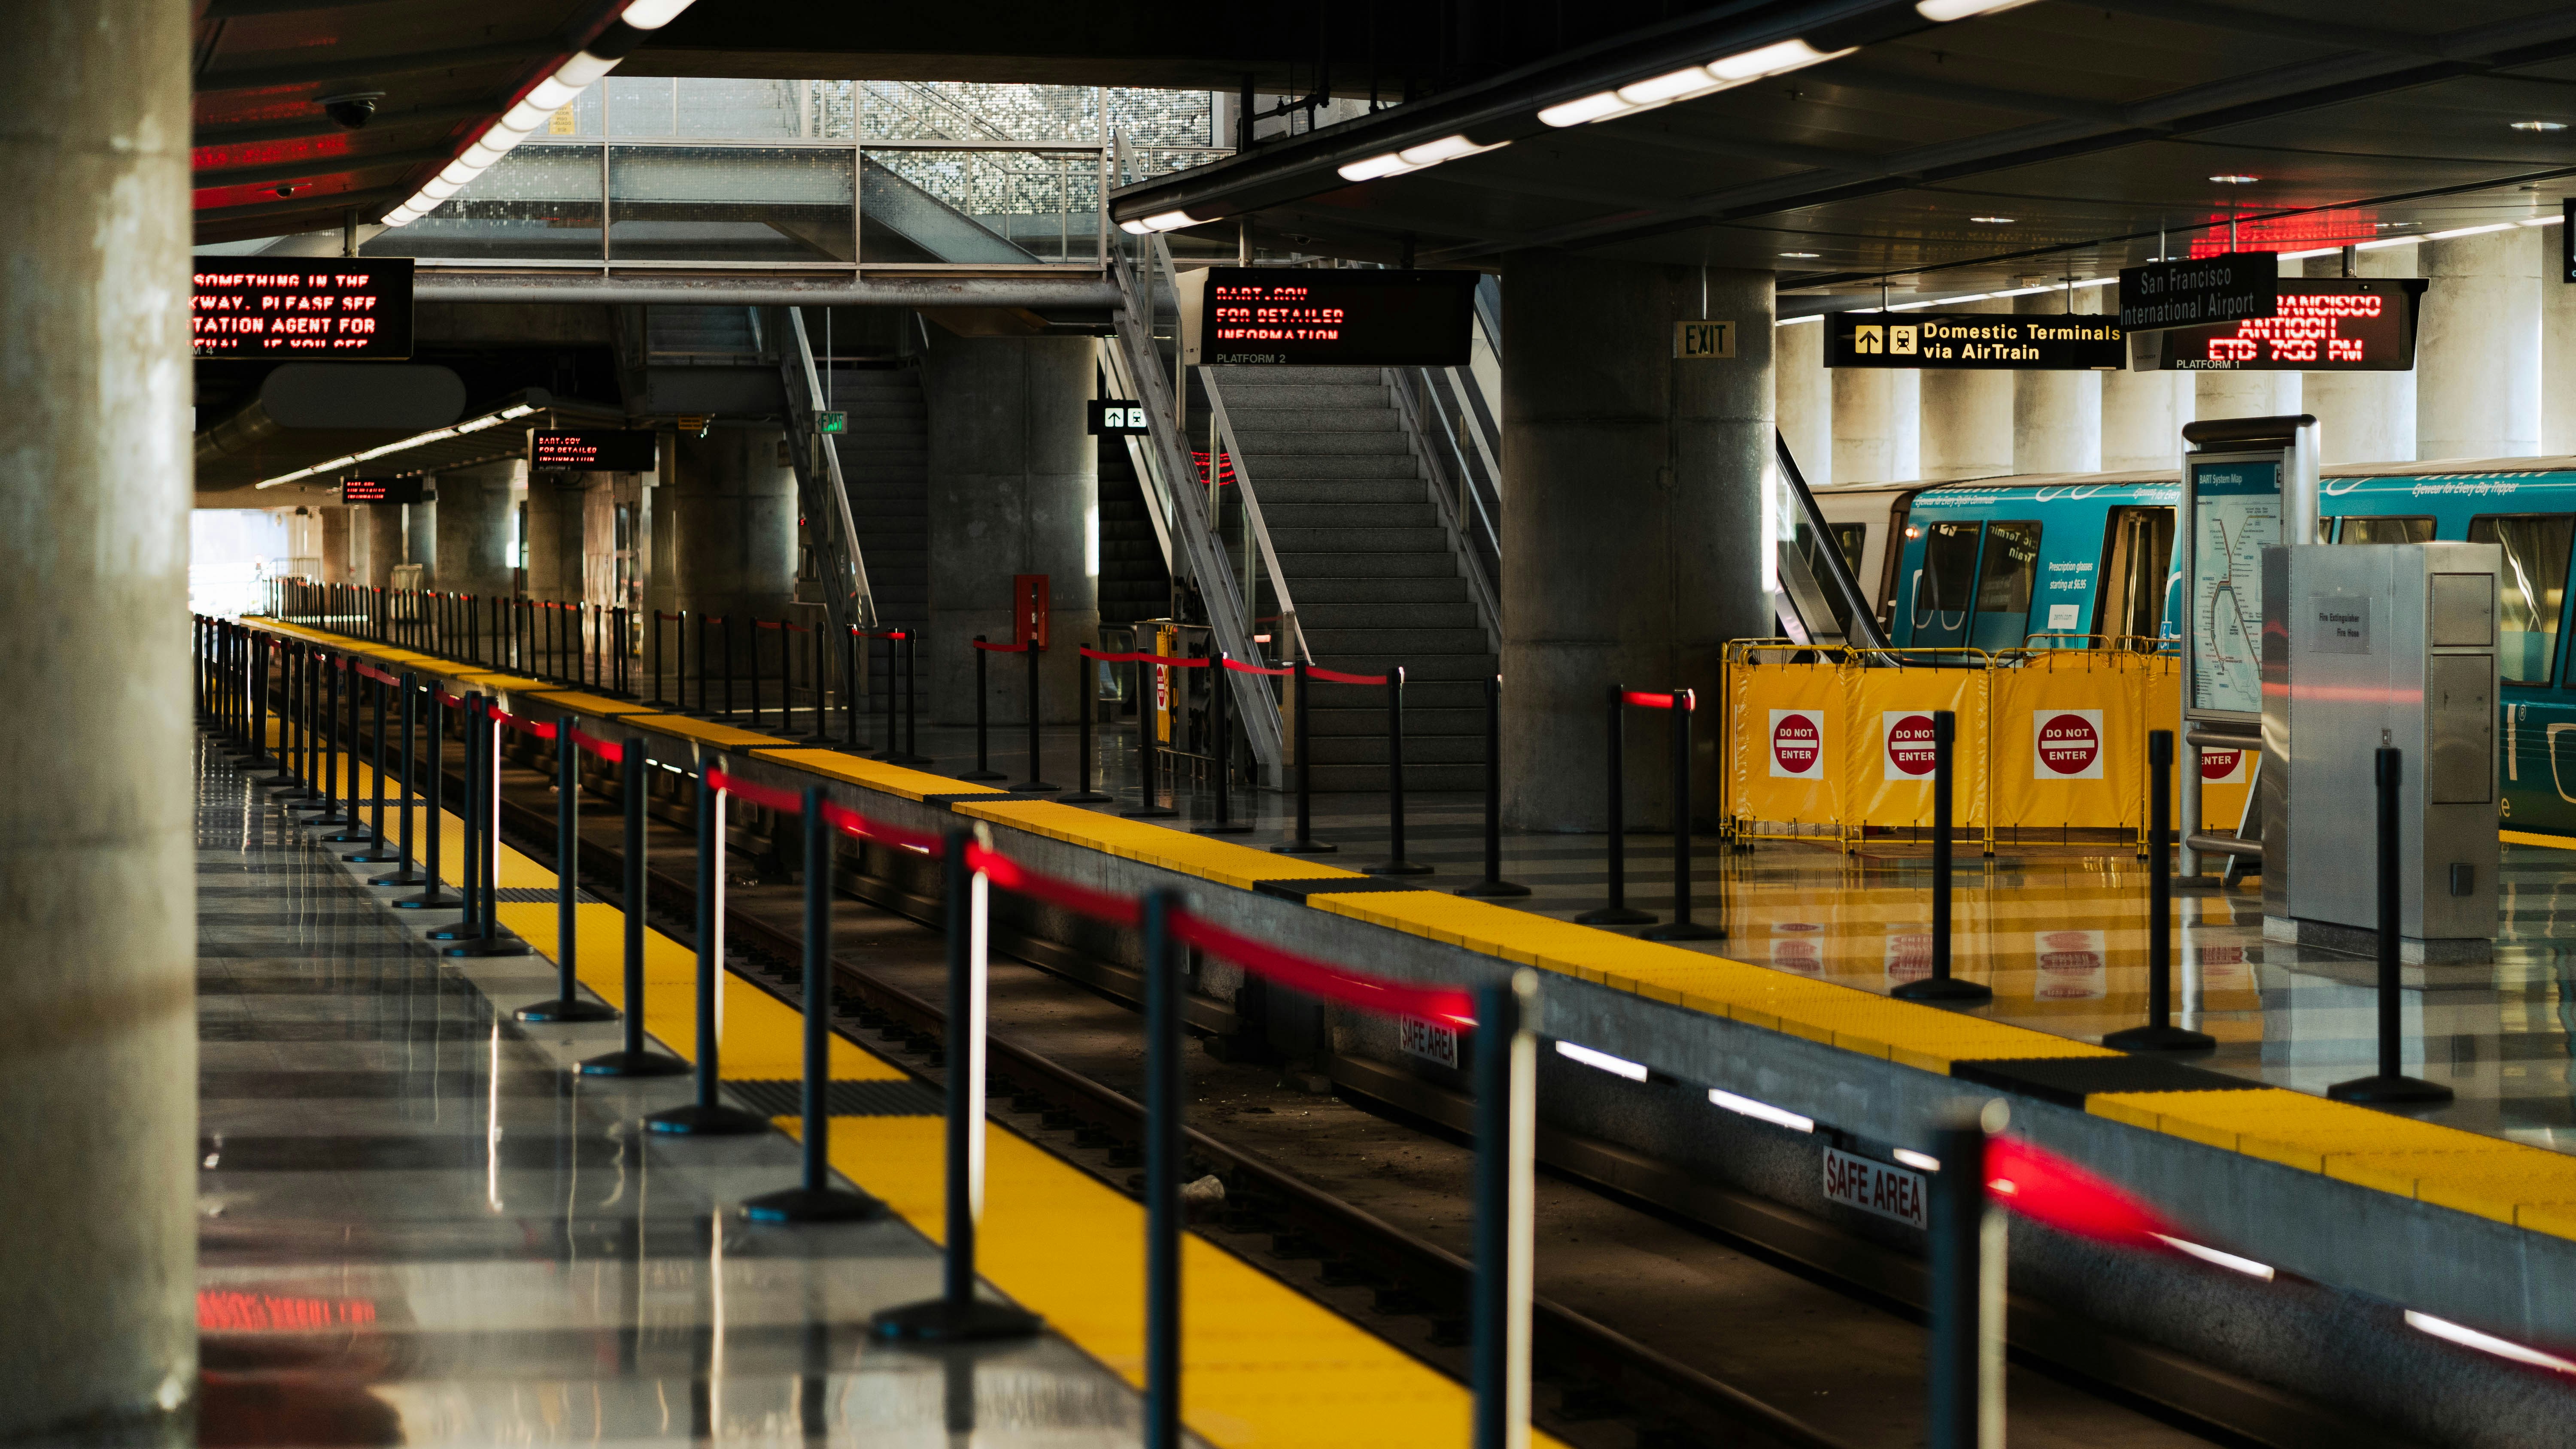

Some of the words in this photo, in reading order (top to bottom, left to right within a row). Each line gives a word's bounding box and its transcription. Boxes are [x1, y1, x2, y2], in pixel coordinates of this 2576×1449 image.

[308, 275, 327, 288] IN
[2141, 272, 2164, 294] San
[2169, 265, 2232, 291] Francisco
[2120, 295, 2201, 326] International
[2208, 291, 2254, 318] Airport
[2277, 295, 2382, 318] RANCISCO
[1216, 308, 1250, 323] FOR
[193, 317, 264, 333] TATION
[271, 317, 332, 333] AGENT
[339, 317, 376, 333] FOR
[1924, 322, 2018, 340] Domestic
[2027, 324, 2121, 341] Terminals
[1686, 325, 1726, 354] EXIT
[1923, 344, 1952, 359] via
[1961, 343, 2040, 360] AirTrain
[1217, 354, 1275, 364] PLATFORM
[1279, 354, 1286, 363] 2
[2176, 359, 2231, 369] PLATFORM
[2235, 360, 2240, 369] 1
[821, 412, 844, 432] EXIT
[2199, 474, 2212, 484] BART
[2213, 474, 2230, 486] System
[2231, 473, 2242, 485] Map
[2155, 490, 2165, 500] for
[2164, 490, 2181, 502] Every
[2412, 483, 2444, 498] Eyewear
[2442, 482, 2454, 494] for
[2453, 482, 2476, 497] Every
[2475, 482, 2491, 496] Bay
[2491, 481, 2519, 496] Tripper
[2049, 561, 2076, 573] Prescription
[2076, 561, 2093, 573] glasses
[2050, 579, 2068, 591] starting
[2067, 580, 2074, 589] at
[2319, 612, 2328, 621] Fire
[2337, 628, 2345, 637] Fire
[1780, 728, 1792, 737] DO
[1794, 729, 1813, 737] NOT
[1896, 730, 1911, 739] DO
[1914, 730, 1935, 738] NOT
[2046, 729, 2062, 738] DO
[2066, 728, 2089, 737] NOT
[1782, 750, 1811, 759] ENTER
[1899, 752, 1935, 761] ENTER
[2049, 751, 2087, 760] ENTER
[1403, 1014, 1425, 1052] SAFE
[1428, 1026, 1454, 1063] AREA
[1827, 1152, 1868, 1204] SAFE
[1873, 1170, 1921, 1222] AREA
